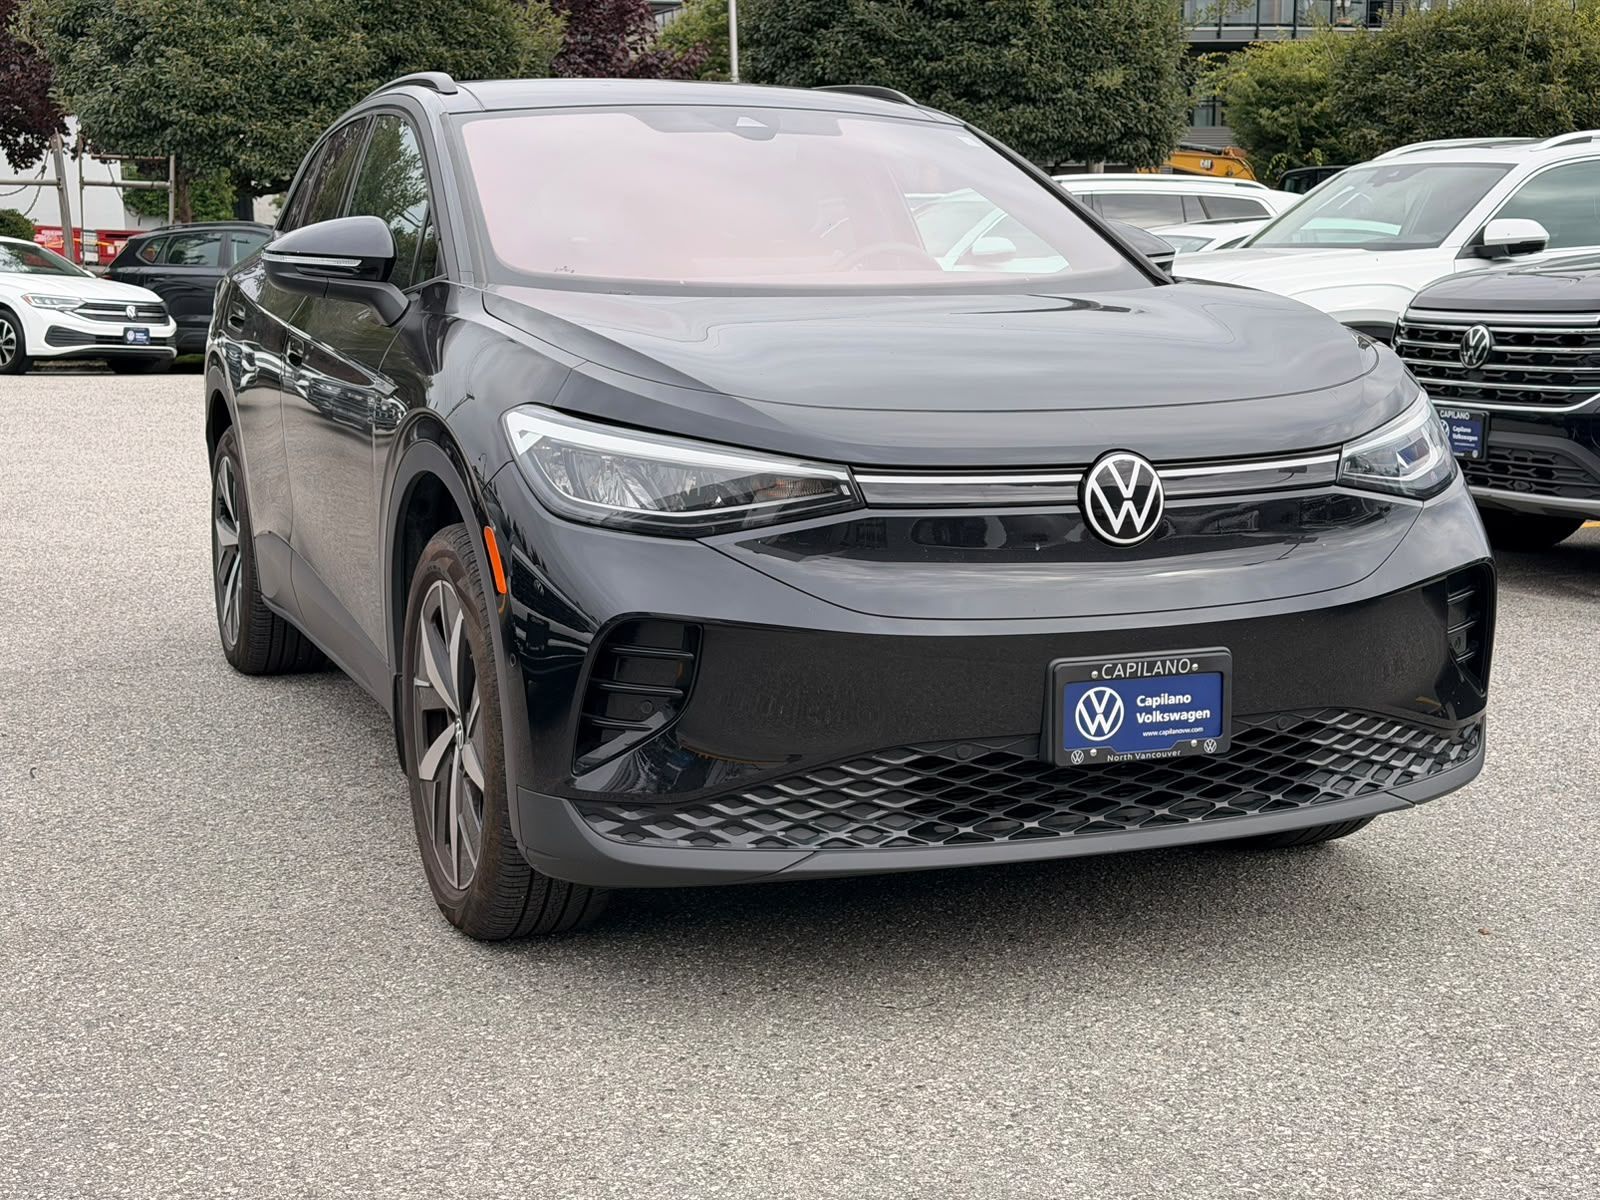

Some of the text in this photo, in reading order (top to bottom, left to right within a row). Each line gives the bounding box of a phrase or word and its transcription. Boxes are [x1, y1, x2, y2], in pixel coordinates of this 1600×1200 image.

[1440, 410, 1470, 420] CAPILANO
[1085, 454, 1164, 544] VW
[1101, 658, 1191, 680] CAPILANO
[1136, 692, 1192, 709] Capilano
[1075, 687, 1125, 741] VW
[1136, 709, 1211, 724] Volkswagen
[1142, 726, 1204, 737] www.capilanovw.com
[1107, 750, 1182, 762] North Vancouver
